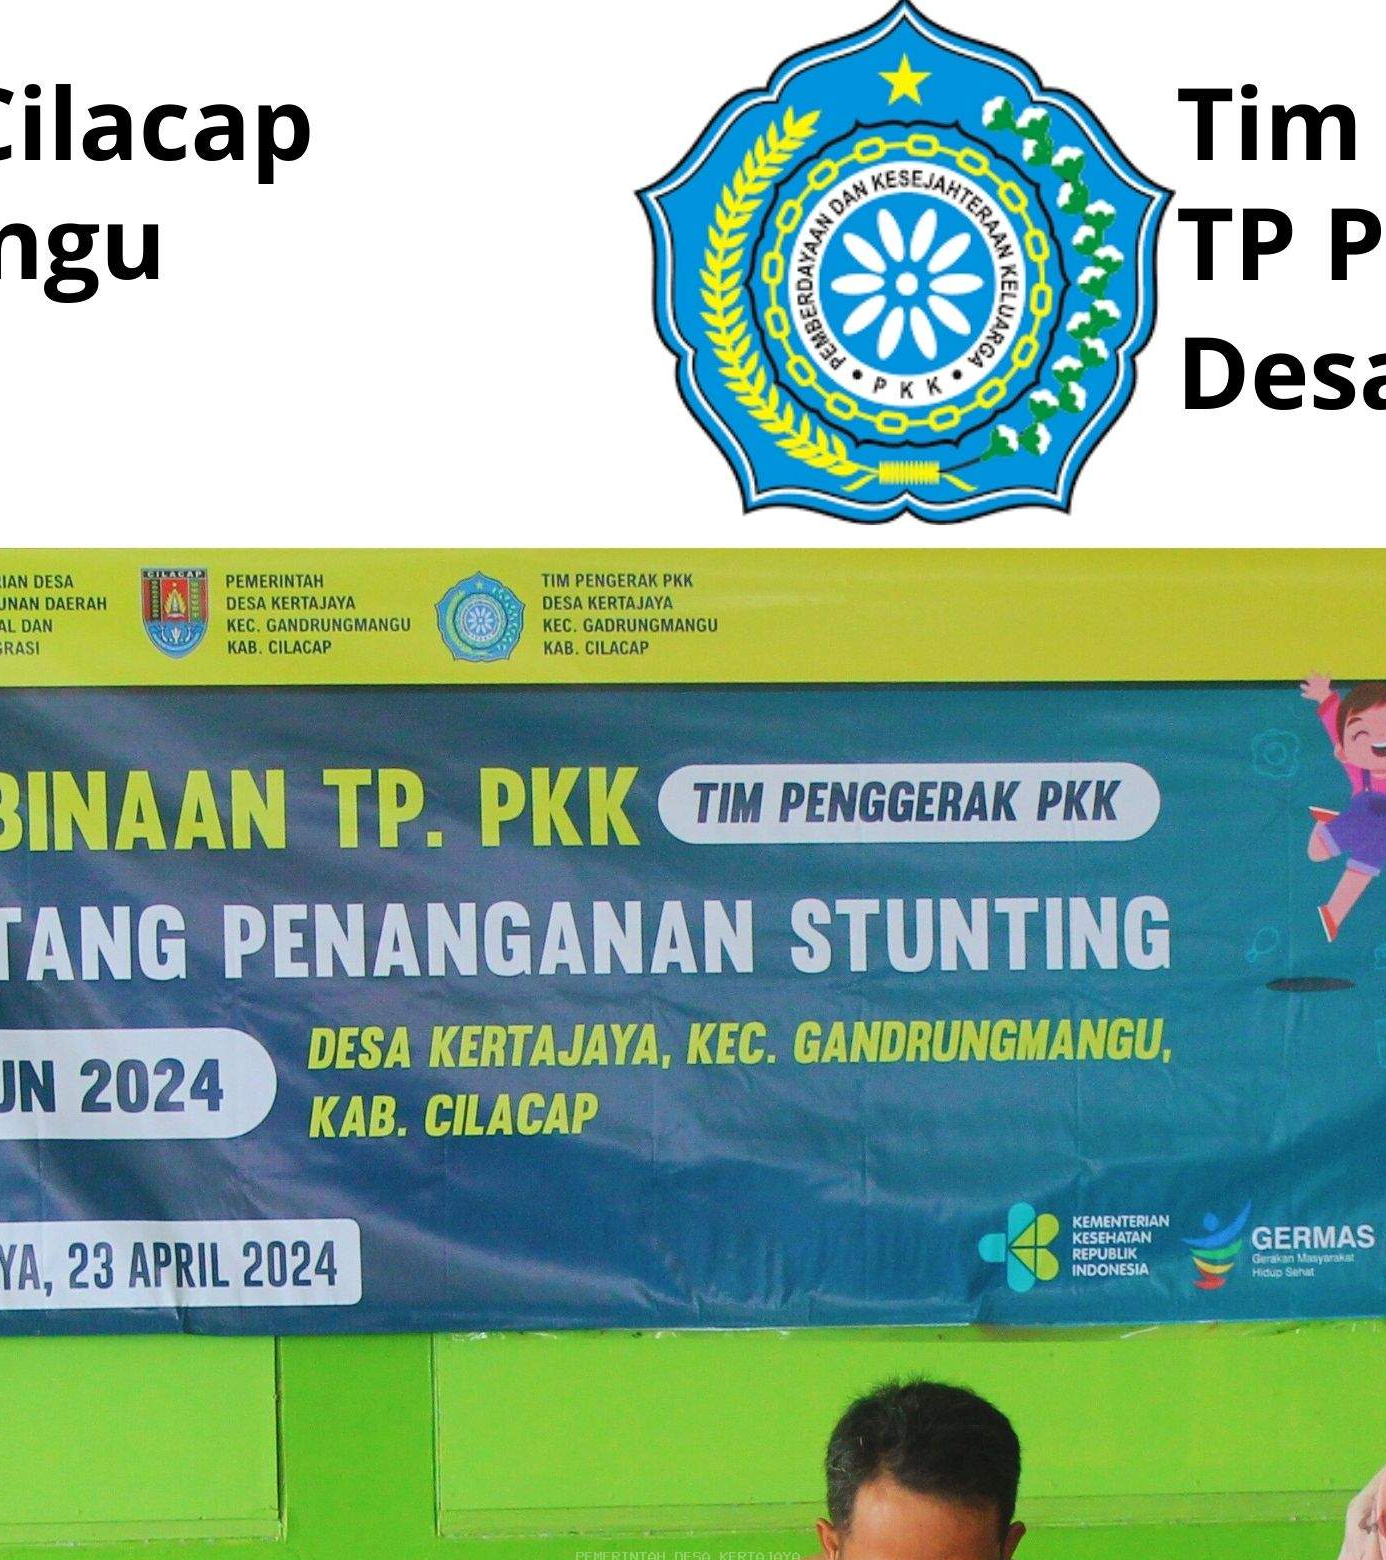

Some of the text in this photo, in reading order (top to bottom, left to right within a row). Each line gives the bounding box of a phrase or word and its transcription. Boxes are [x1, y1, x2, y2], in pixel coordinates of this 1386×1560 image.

[34, 575, 74, 588] DESA
[226, 574, 324, 588] PEMERINTAH
[541, 573, 693, 588] TIM PENGERAK PKK
[45, 597, 107, 610] DAERAH
[226, 596, 356, 610] DESA KERTAJAYA
[542, 596, 673, 610] DESA KERTAJAYA
[22, 619, 53, 633] DAN
[227, 618, 411, 632] KEC. GANDRUNGMANGU
[543, 618, 718, 633] KEC. GADRUNGMANGU
[228, 640, 332, 654] KAB. CILACAP
[544, 641, 649, 655] KAB. CILACAP
[322, 767, 443, 848] TP.
[480, 767, 641, 848] PKK
[693, 780, 1121, 823] TIM PENGGERAK PKK
[223, 900, 754, 979] PENANGANAN
[790, 895, 1170, 973] STUNTING
[307, 1018, 1172, 1069] DESA KERTAJAYA, KEC. GANDRUNGMANGU,
[80, 1058, 224, 1113] 2024
[309, 1092, 599, 1138] KAB. CILACAP
[1072, 1214, 1170, 1229] KEMENTERIAN
[1072, 1231, 1152, 1246] KESEHATAN
[1251, 1225, 1375, 1251] GERMAS
[1072, 1247, 1137, 1261] REPUBLIK
[1252, 1253, 1354, 1266] Gerakan Masyarakat
[68, 1242, 114, 1289] 23
[129, 1240, 229, 1288] APRIL
[242, 1240, 338, 1287] 2024
[1072, 1263, 1150, 1277] INDONESIA
[1252, 1267, 1314, 1279] Hidup Sehat
